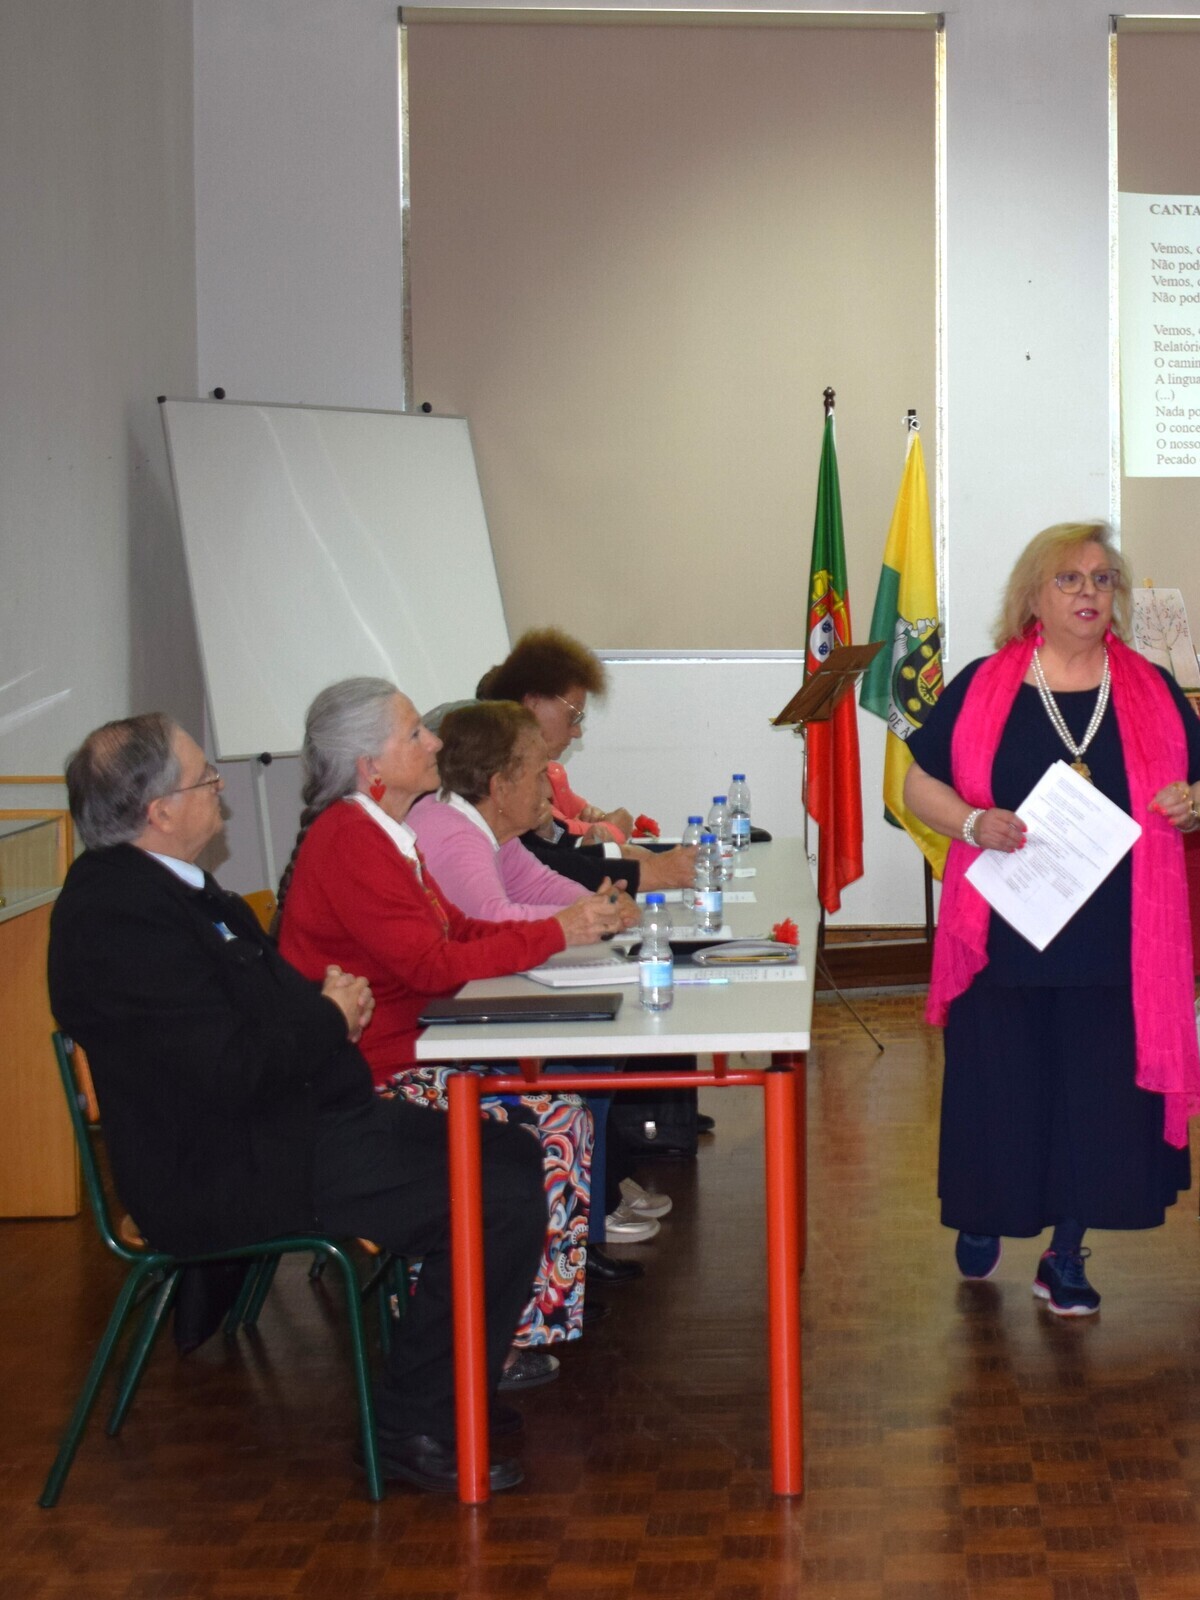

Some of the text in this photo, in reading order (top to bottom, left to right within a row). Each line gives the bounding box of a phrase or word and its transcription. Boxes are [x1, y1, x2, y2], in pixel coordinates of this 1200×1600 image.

[1151, 243, 1192, 255] Vemos,
[1151, 259, 1175, 271] Não
[1152, 275, 1193, 288] Vemos,
[1152, 292, 1176, 303] Não
[1154, 325, 1195, 337] Vemos,
[1154, 358, 1164, 368] O
[1155, 375, 1164, 384] A
[1156, 406, 1184, 417] Nada
[1156, 423, 1166, 433] O
[1157, 439, 1166, 449] O
[1170, 440, 1200, 449] nosso
[1157, 454, 1196, 465] Pecado
[889, 712, 904, 730] DE
